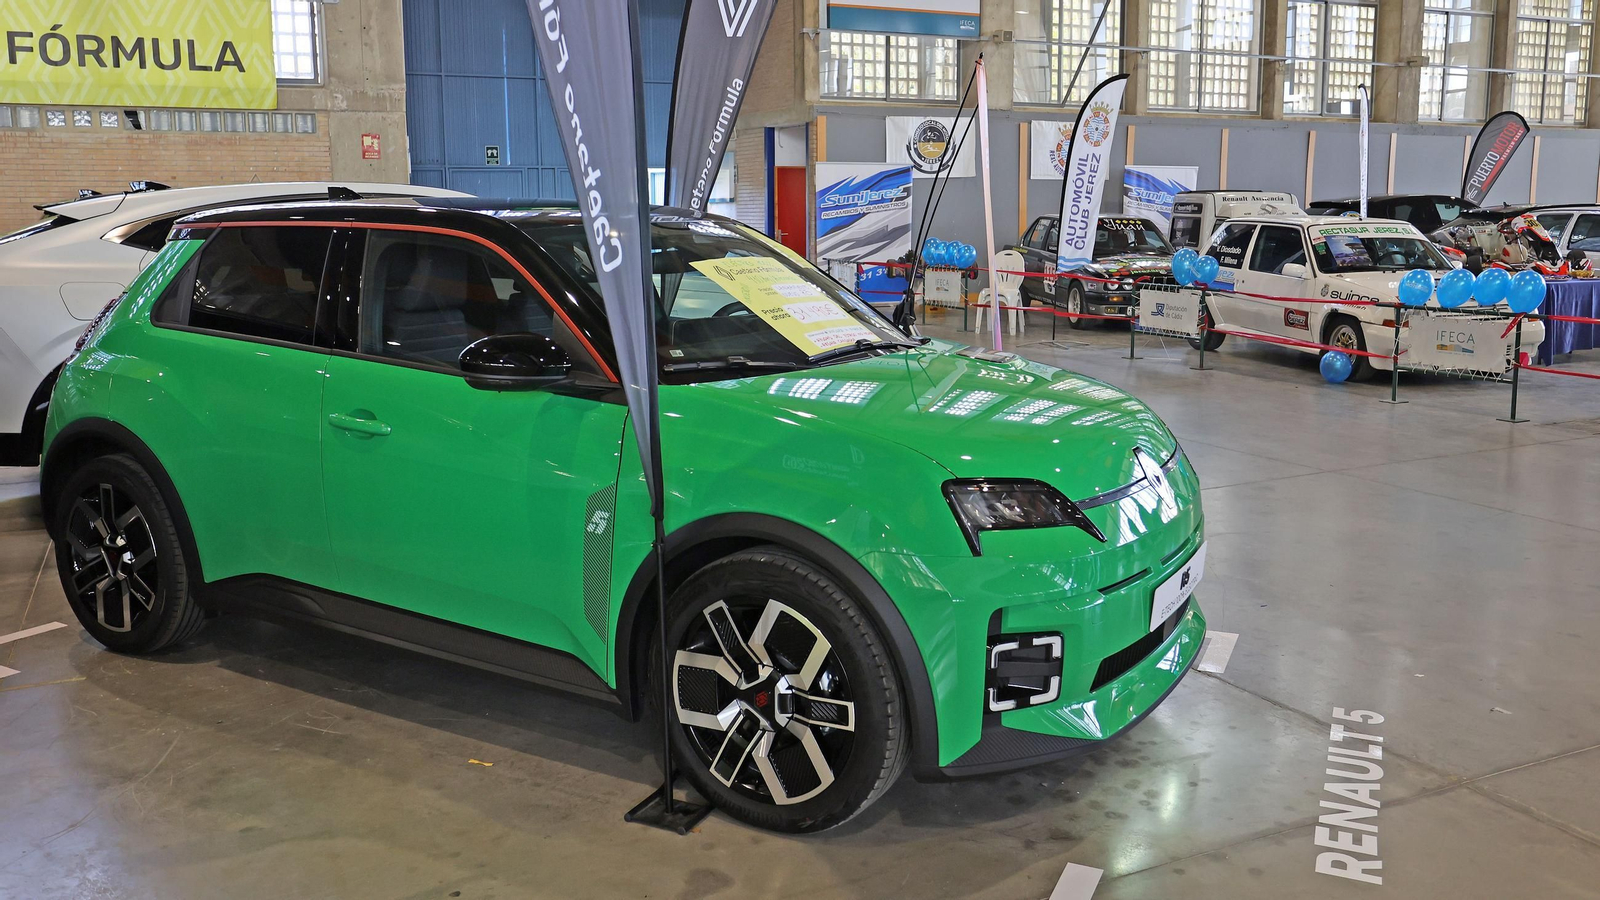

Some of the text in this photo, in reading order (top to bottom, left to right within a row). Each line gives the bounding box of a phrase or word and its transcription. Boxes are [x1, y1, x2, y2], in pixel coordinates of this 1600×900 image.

[959, 19, 975, 27] IFECA
[6, 23, 246, 73] FÓRMULA
[564, 82, 623, 273] Caetano
[1065, 153, 1090, 247] AUTOMÓVIL
[1074, 152, 1101, 250] CLUB JEREZ
[822, 208, 859, 218] RECAMBIOS
[865, 201, 907, 212] SUMINISTROS
[1319, 227, 1369, 235] RECTASUR
[761, 306, 784, 316] Precio
[1166, 303, 1188, 313] Diputación
[771, 312, 791, 321] ahora
[1436, 330, 1476, 345] IFECA
[1314, 706, 1385, 886] RENAULT 5
